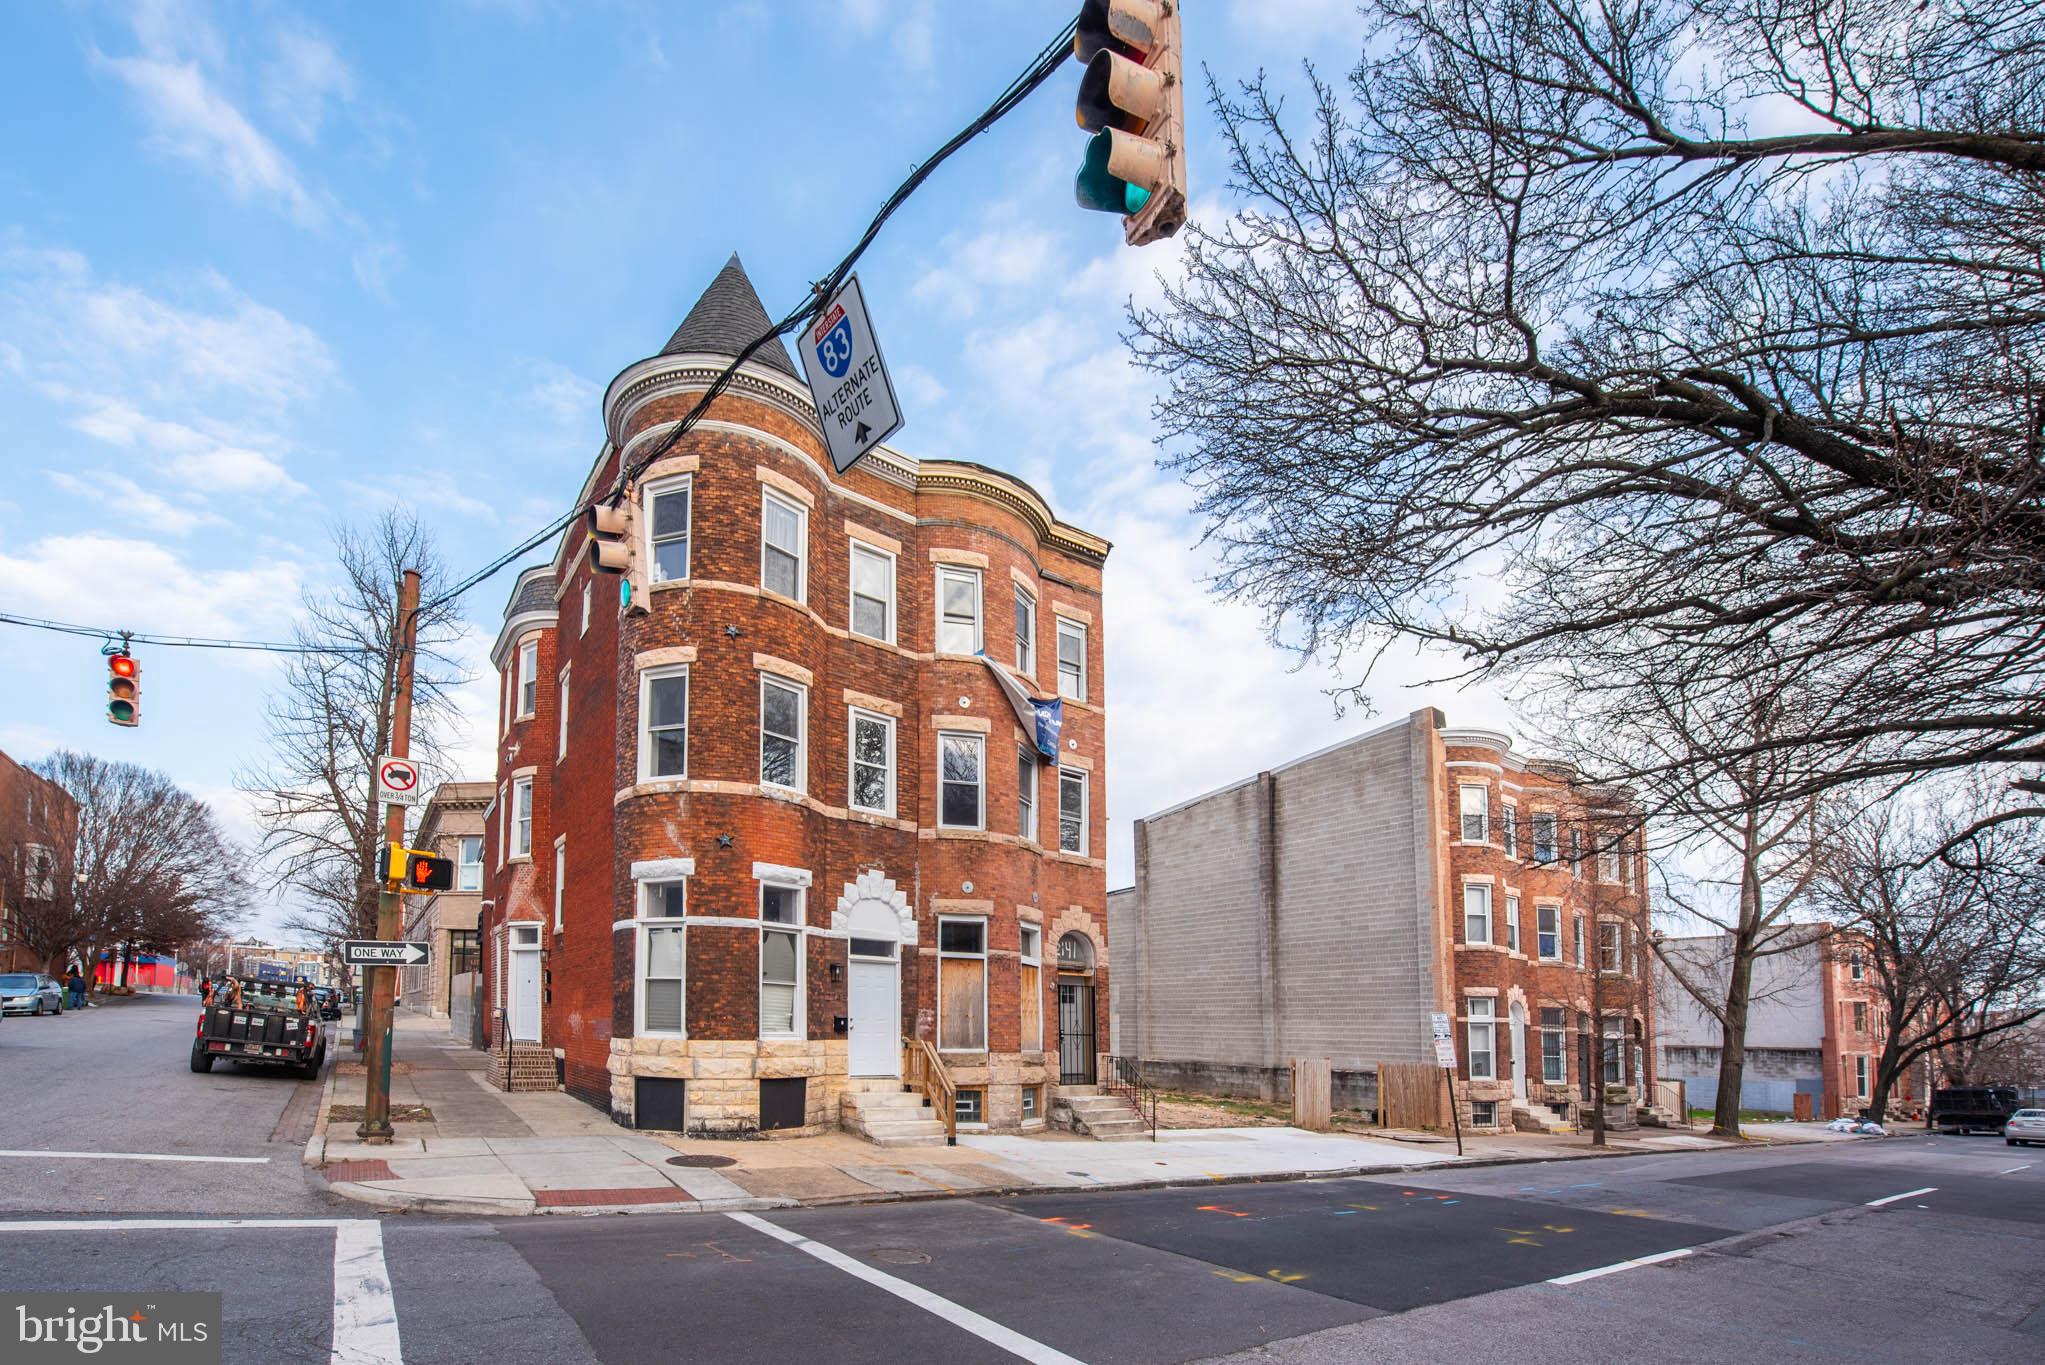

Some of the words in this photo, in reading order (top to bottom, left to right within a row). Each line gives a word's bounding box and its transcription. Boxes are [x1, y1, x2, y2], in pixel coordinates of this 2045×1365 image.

[816, 307, 842, 341] INTERSTATE
[823, 327, 850, 372] 83
[822, 355, 879, 421] ALTERNATE
[837, 387, 873, 430] ROUTE
[380, 791, 394, 799] OVER
[354, 948, 377, 958] ONE
[381, 949, 404, 959] WAY
